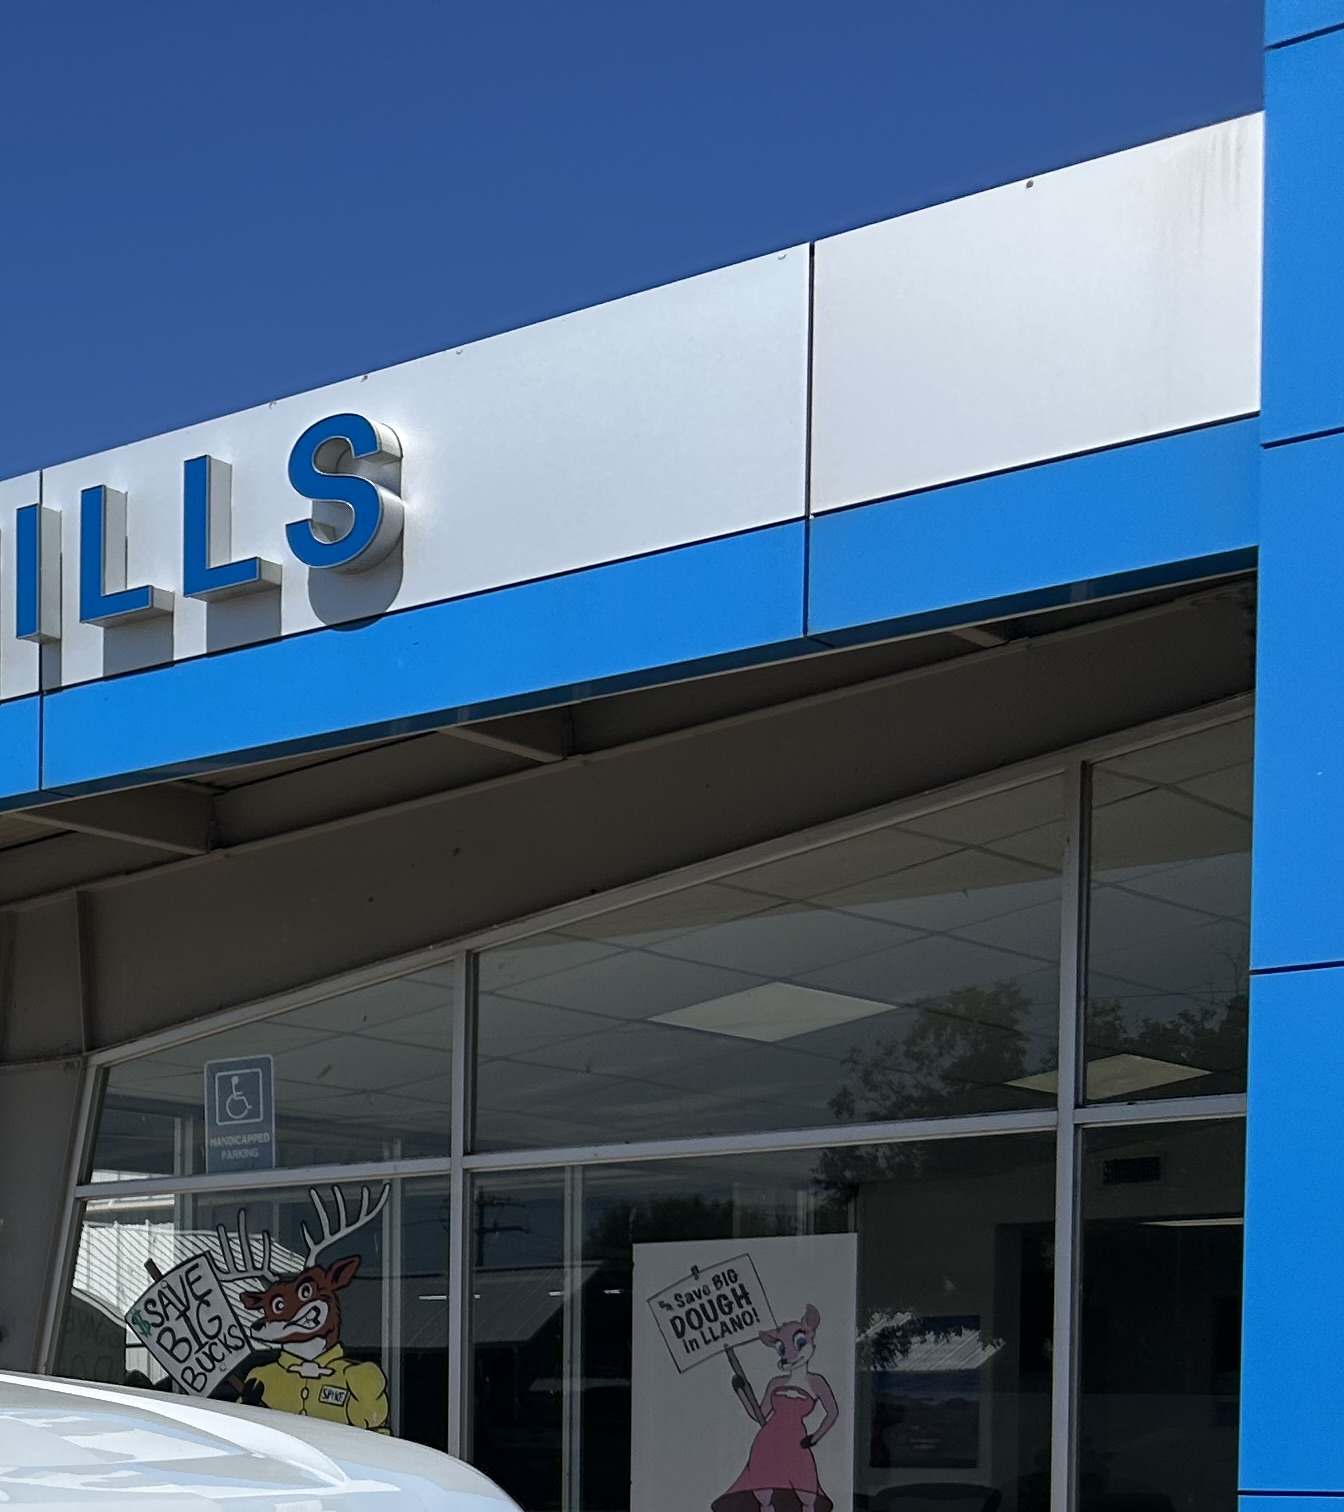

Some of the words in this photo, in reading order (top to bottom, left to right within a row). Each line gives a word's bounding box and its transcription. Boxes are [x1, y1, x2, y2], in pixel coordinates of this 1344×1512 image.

[209, 1131, 271, 1148] HANDICAPPED
[221, 1147, 259, 1160] PARKING
[712, 1268, 739, 1291] BIG
[670, 1283, 752, 1339] DOUGH
[700, 1307, 761, 1345] LLANO!
[156, 1300, 223, 1364] BIG
[181, 1324, 246, 1393] BUCKS
